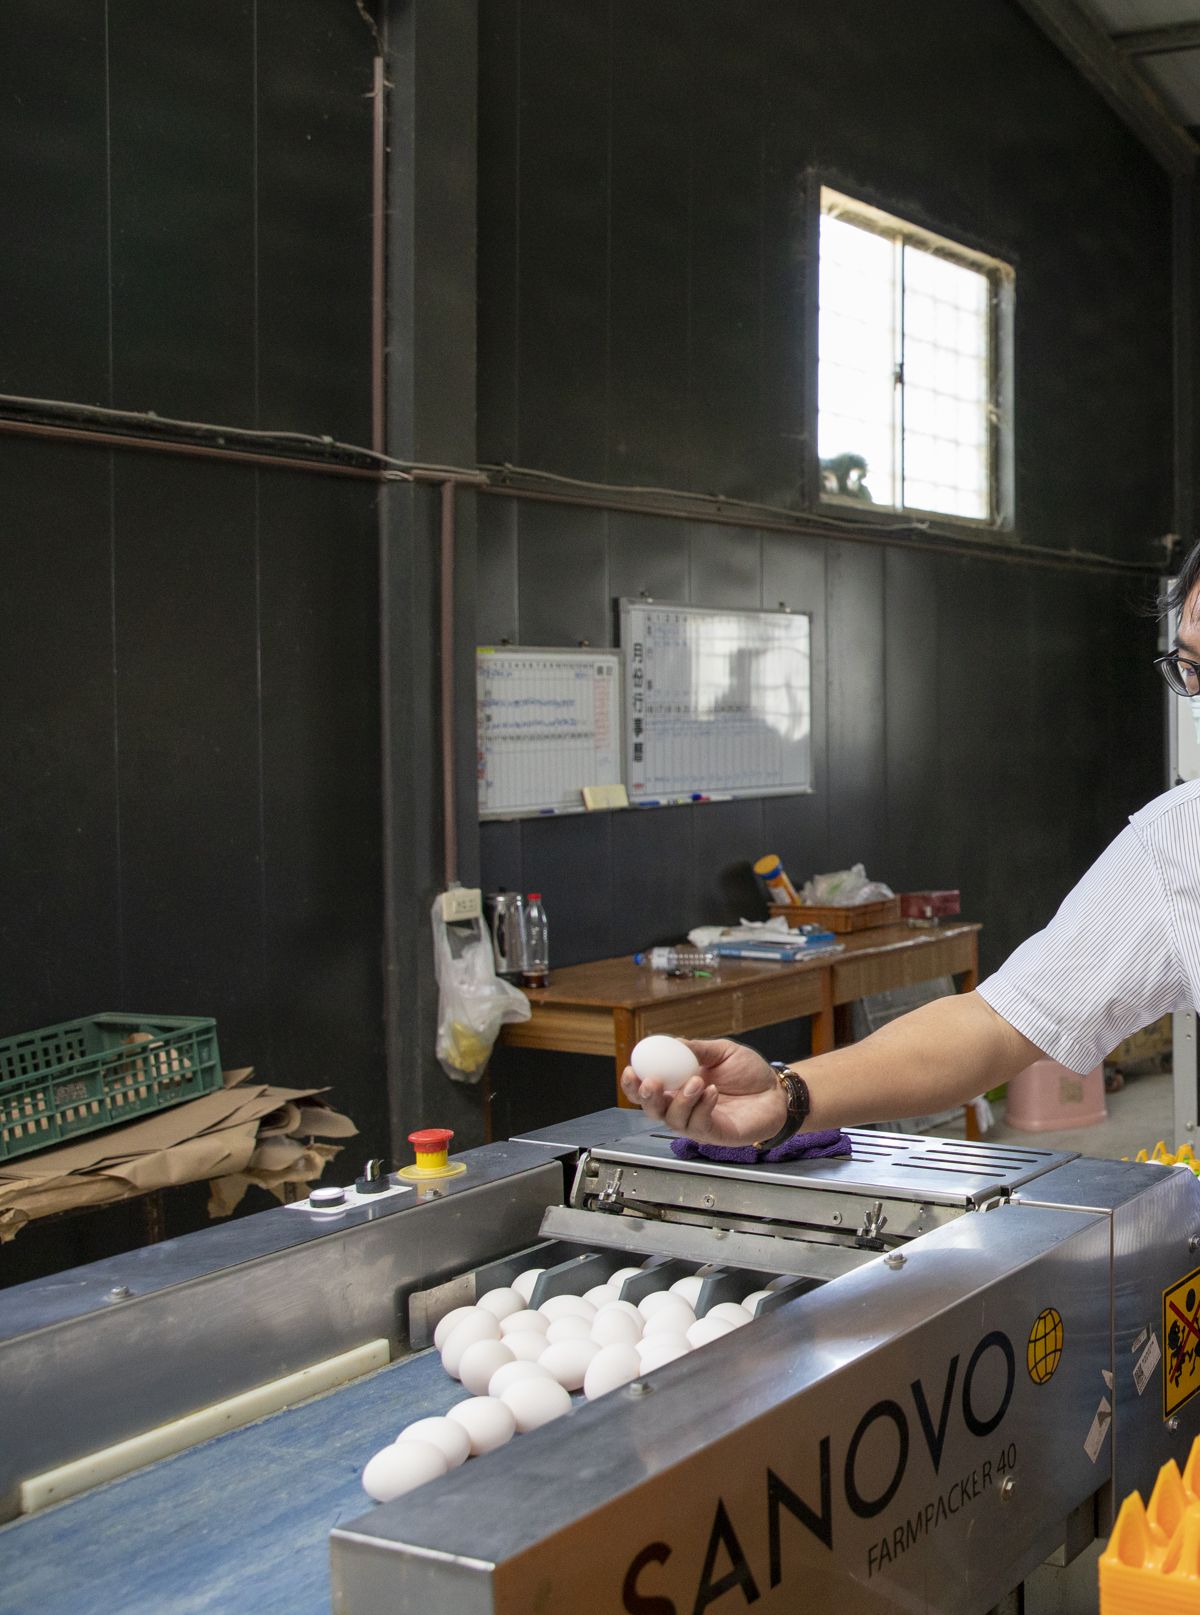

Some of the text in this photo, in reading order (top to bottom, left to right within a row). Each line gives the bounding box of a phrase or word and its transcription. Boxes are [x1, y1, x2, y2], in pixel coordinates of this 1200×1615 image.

[622, 1329, 1016, 1615] SANOVO
[866, 1442, 1018, 1579] FARMPACKER 40
